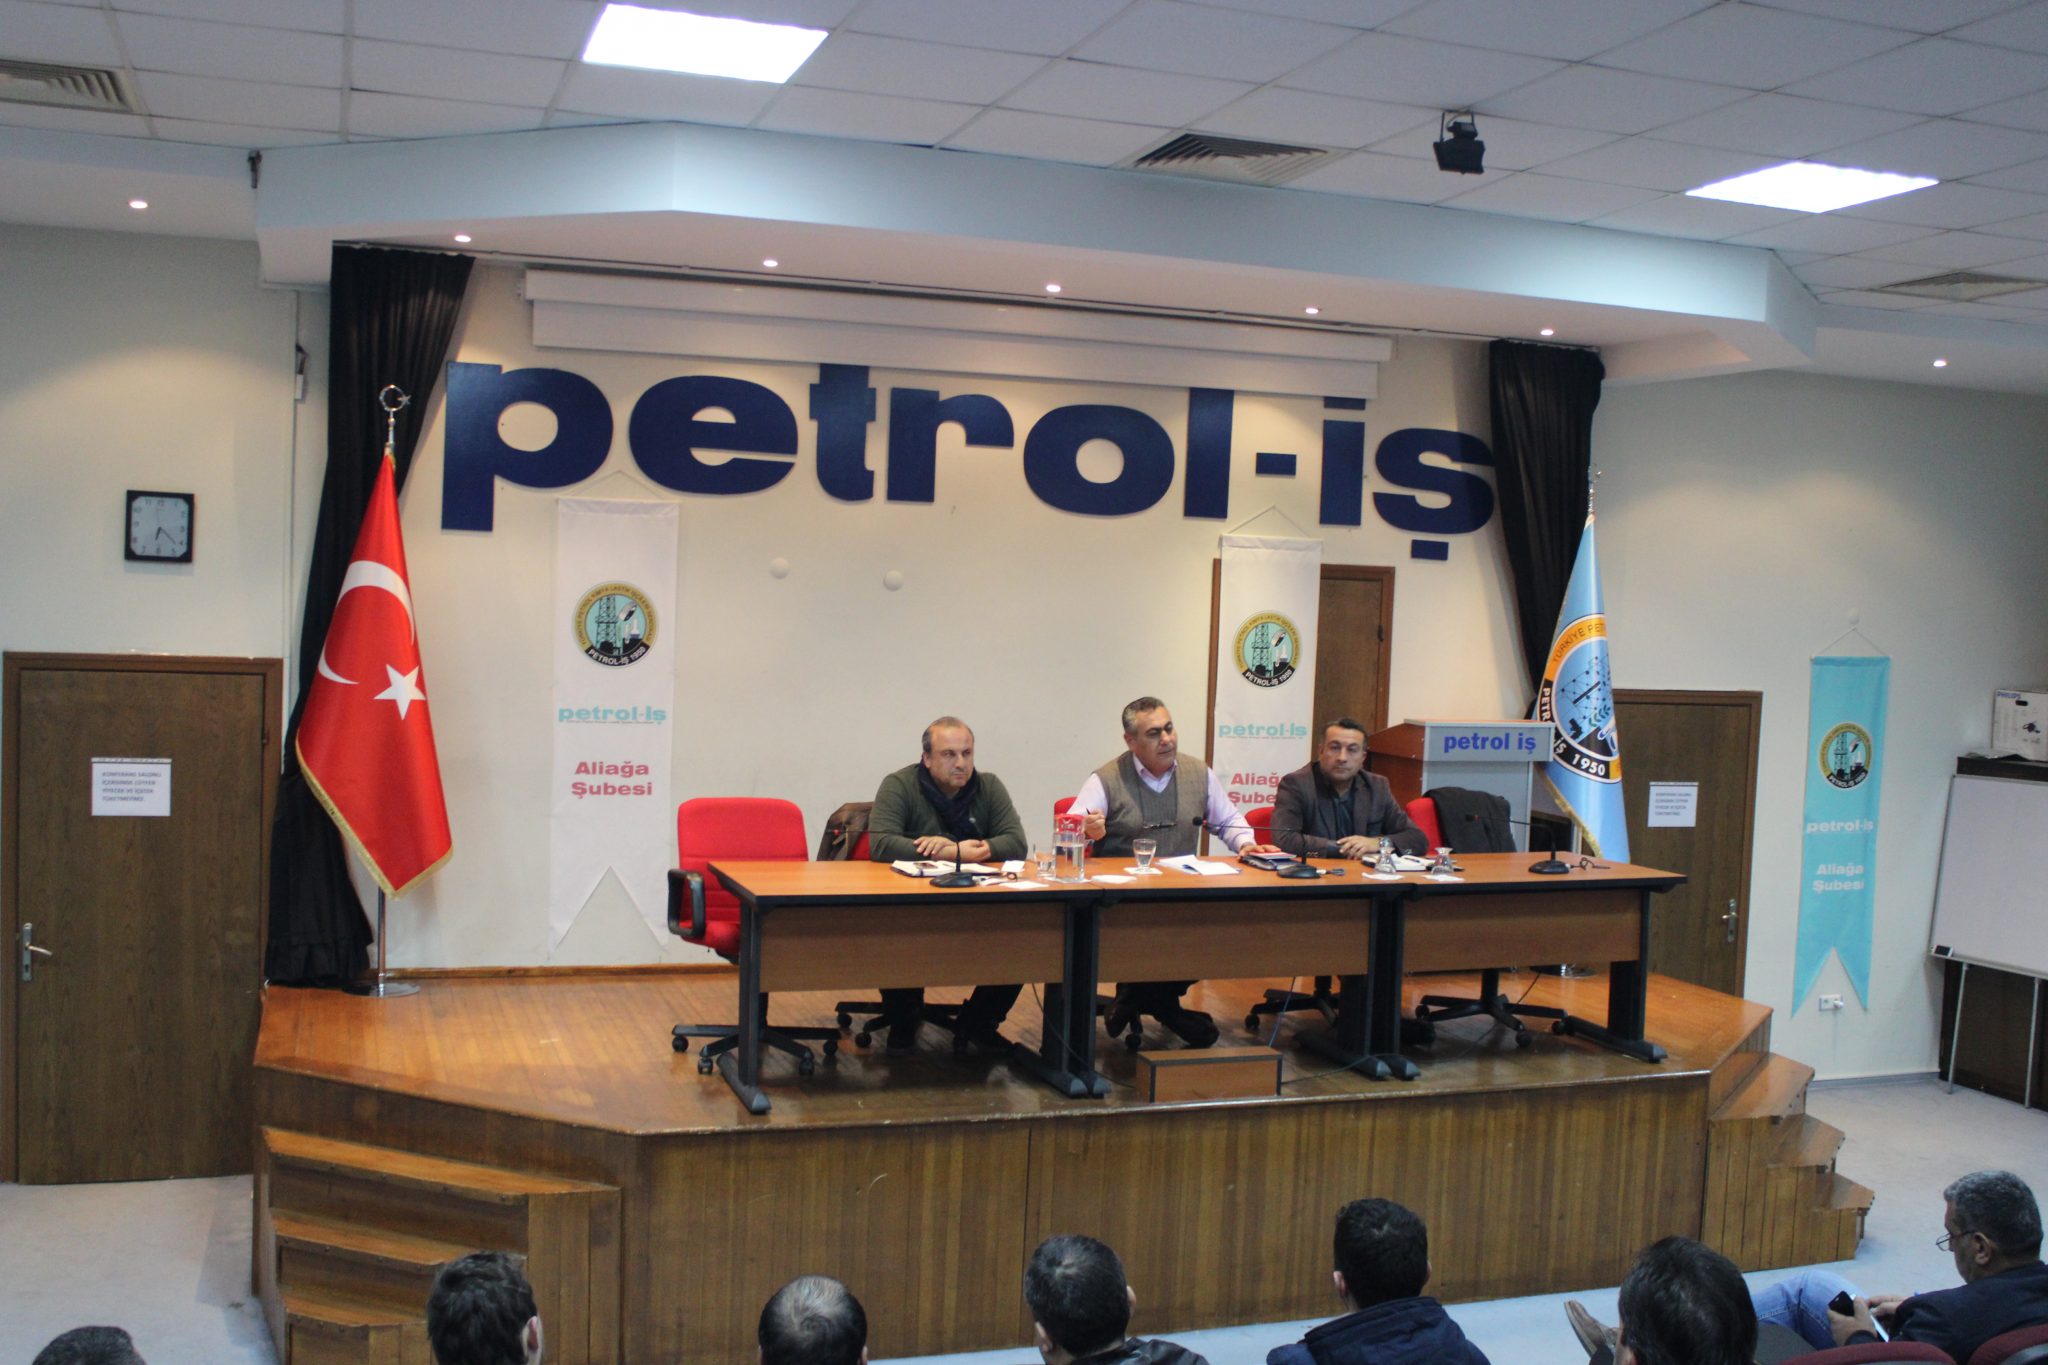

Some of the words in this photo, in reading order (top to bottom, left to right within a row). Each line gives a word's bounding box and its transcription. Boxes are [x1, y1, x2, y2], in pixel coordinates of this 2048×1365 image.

[441, 361, 1495, 560] petrol-iş
[1587, 623, 1607, 634] PET
[1443, 733, 1511, 753] petrol
[1518, 732, 1537, 755] iş
[574, 761, 650, 778] Aliağa
[1572, 754, 1606, 776] 1950
[1231, 772, 1280, 788] Aliağ
[571, 782, 653, 799] Şubesi
[1228, 791, 1276, 807] Şube
[1816, 862, 1865, 877] Aliağa
[1812, 880, 1865, 895] Şubesi
